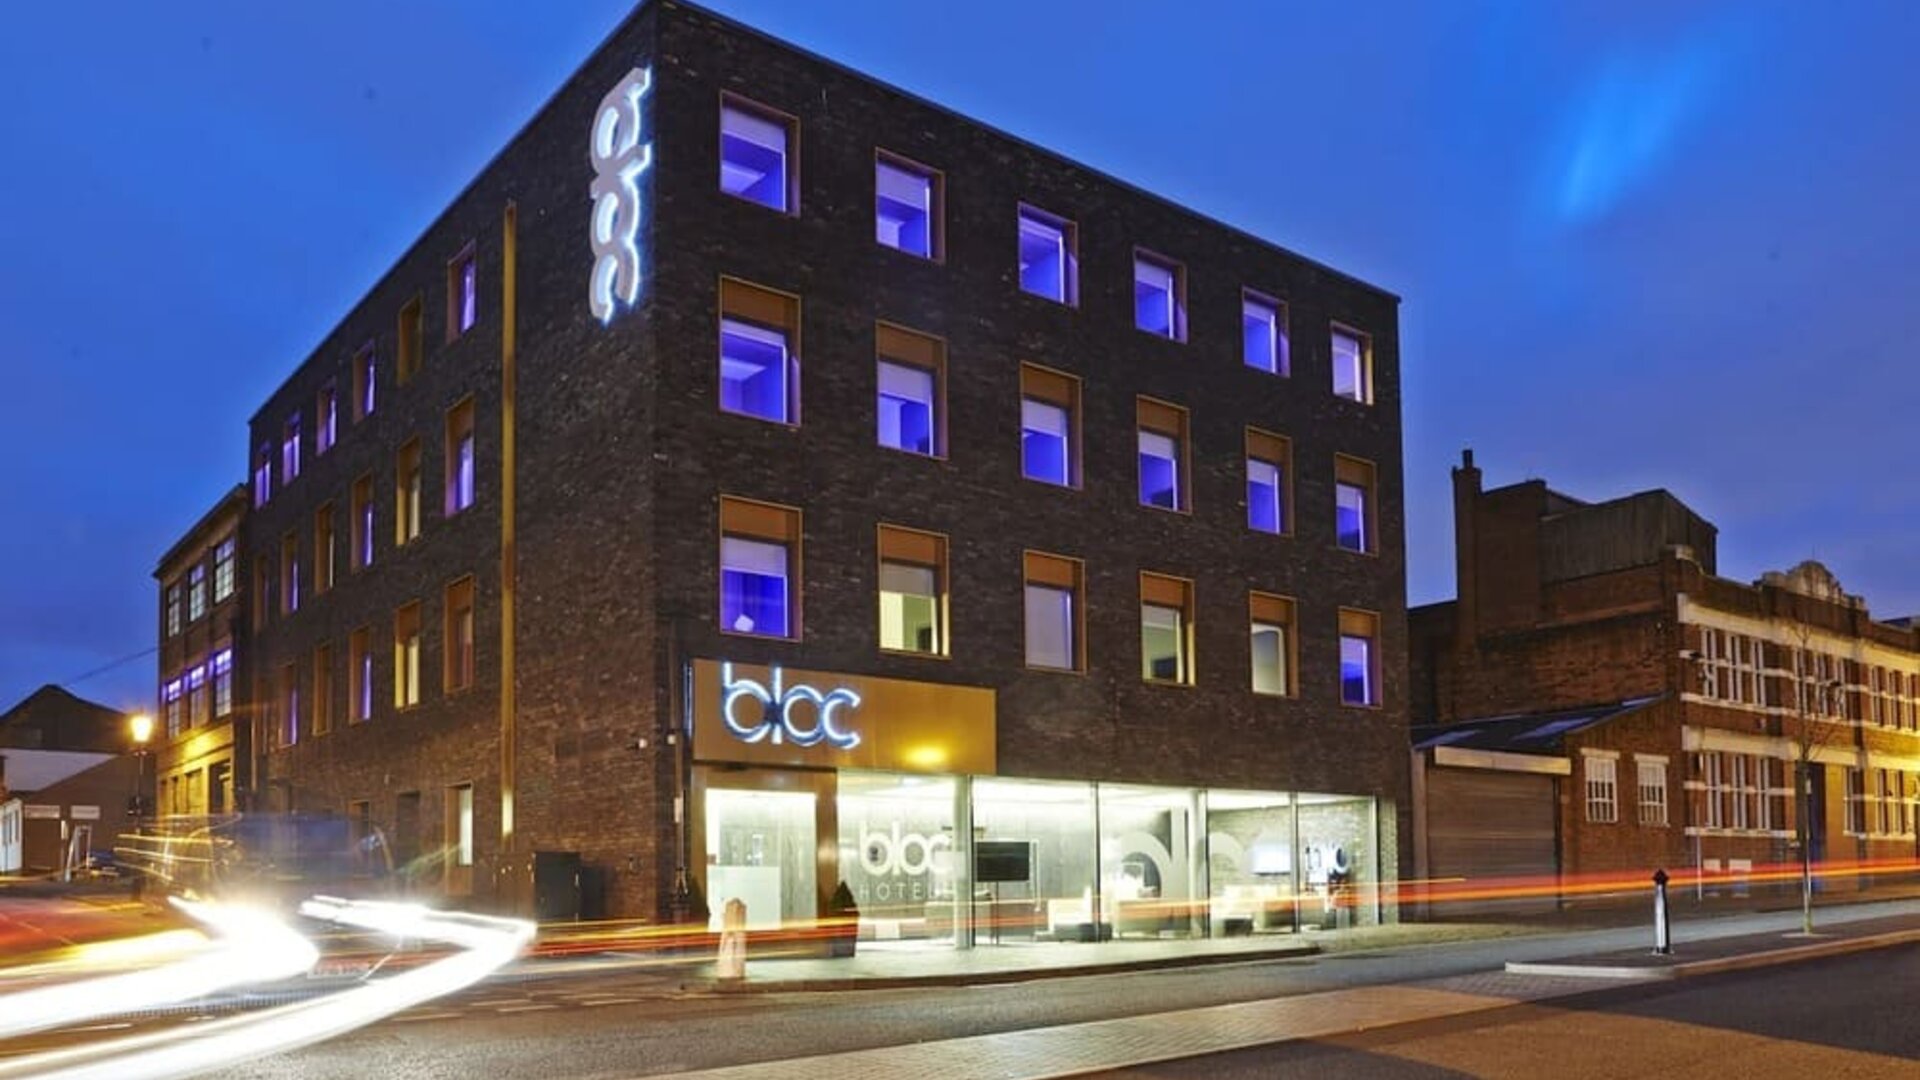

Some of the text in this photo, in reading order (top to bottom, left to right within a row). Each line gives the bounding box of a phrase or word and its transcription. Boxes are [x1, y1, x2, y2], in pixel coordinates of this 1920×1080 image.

[590, 66, 651, 325] bloc
[722, 661, 861, 749] bloc
[860, 820, 952, 876] bloc
